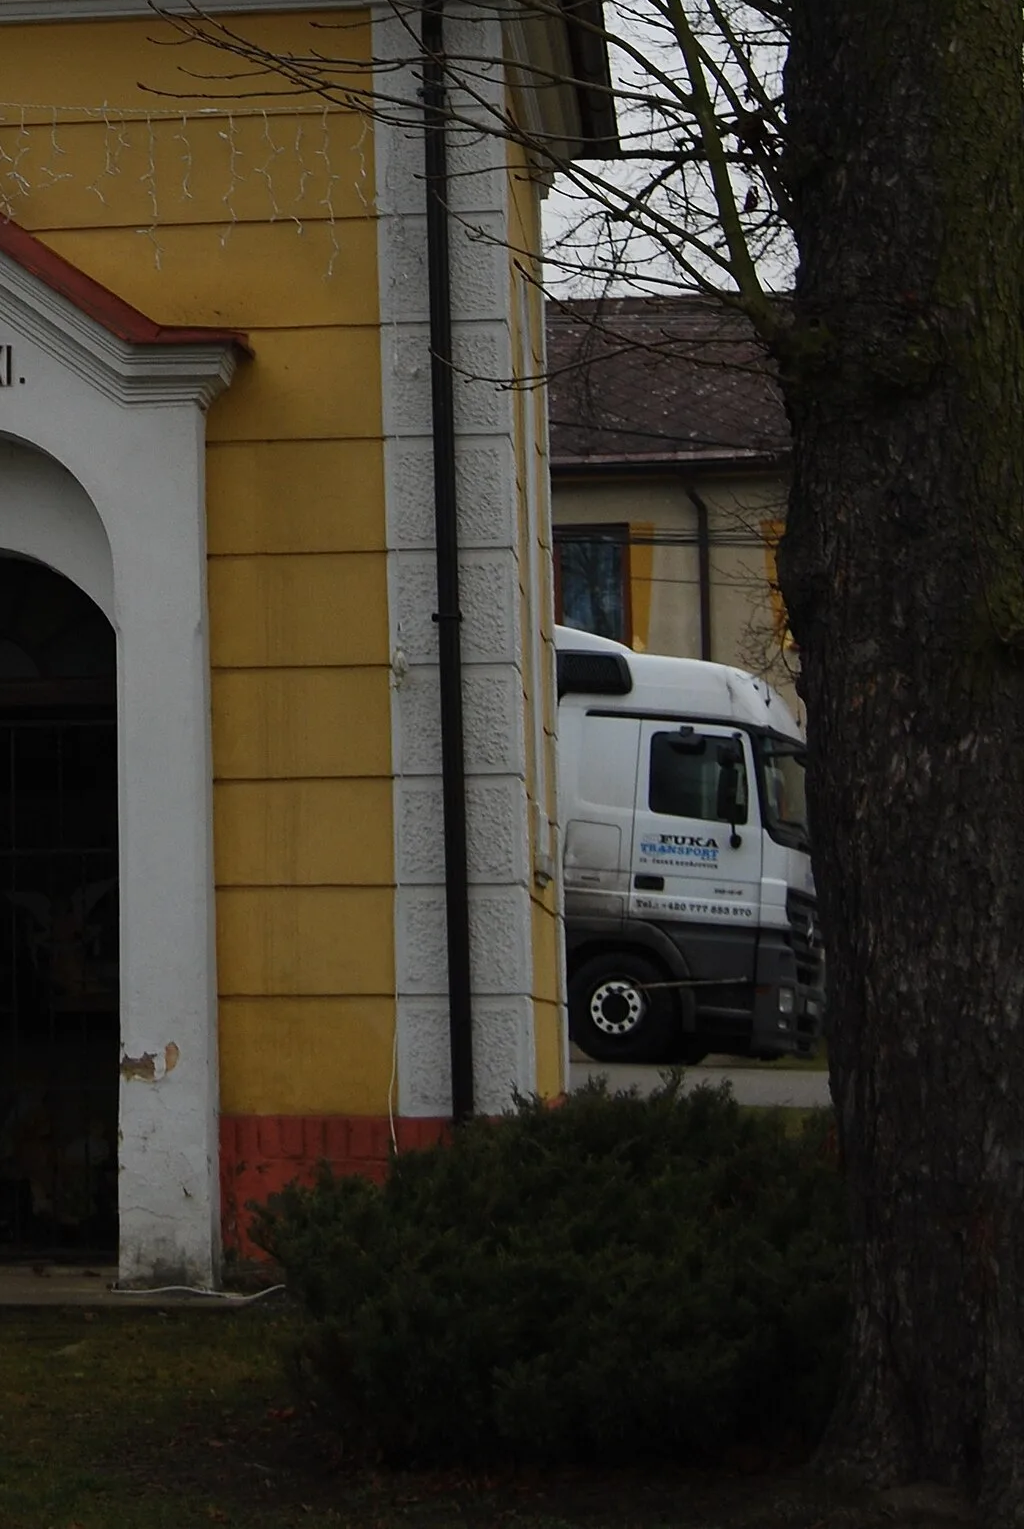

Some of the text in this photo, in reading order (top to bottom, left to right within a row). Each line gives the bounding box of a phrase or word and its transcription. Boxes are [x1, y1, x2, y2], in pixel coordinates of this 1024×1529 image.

[659, 834, 719, 848] FUKA
[640, 842, 719, 858] TRANSPORT
[689, 903, 708, 913] 777
